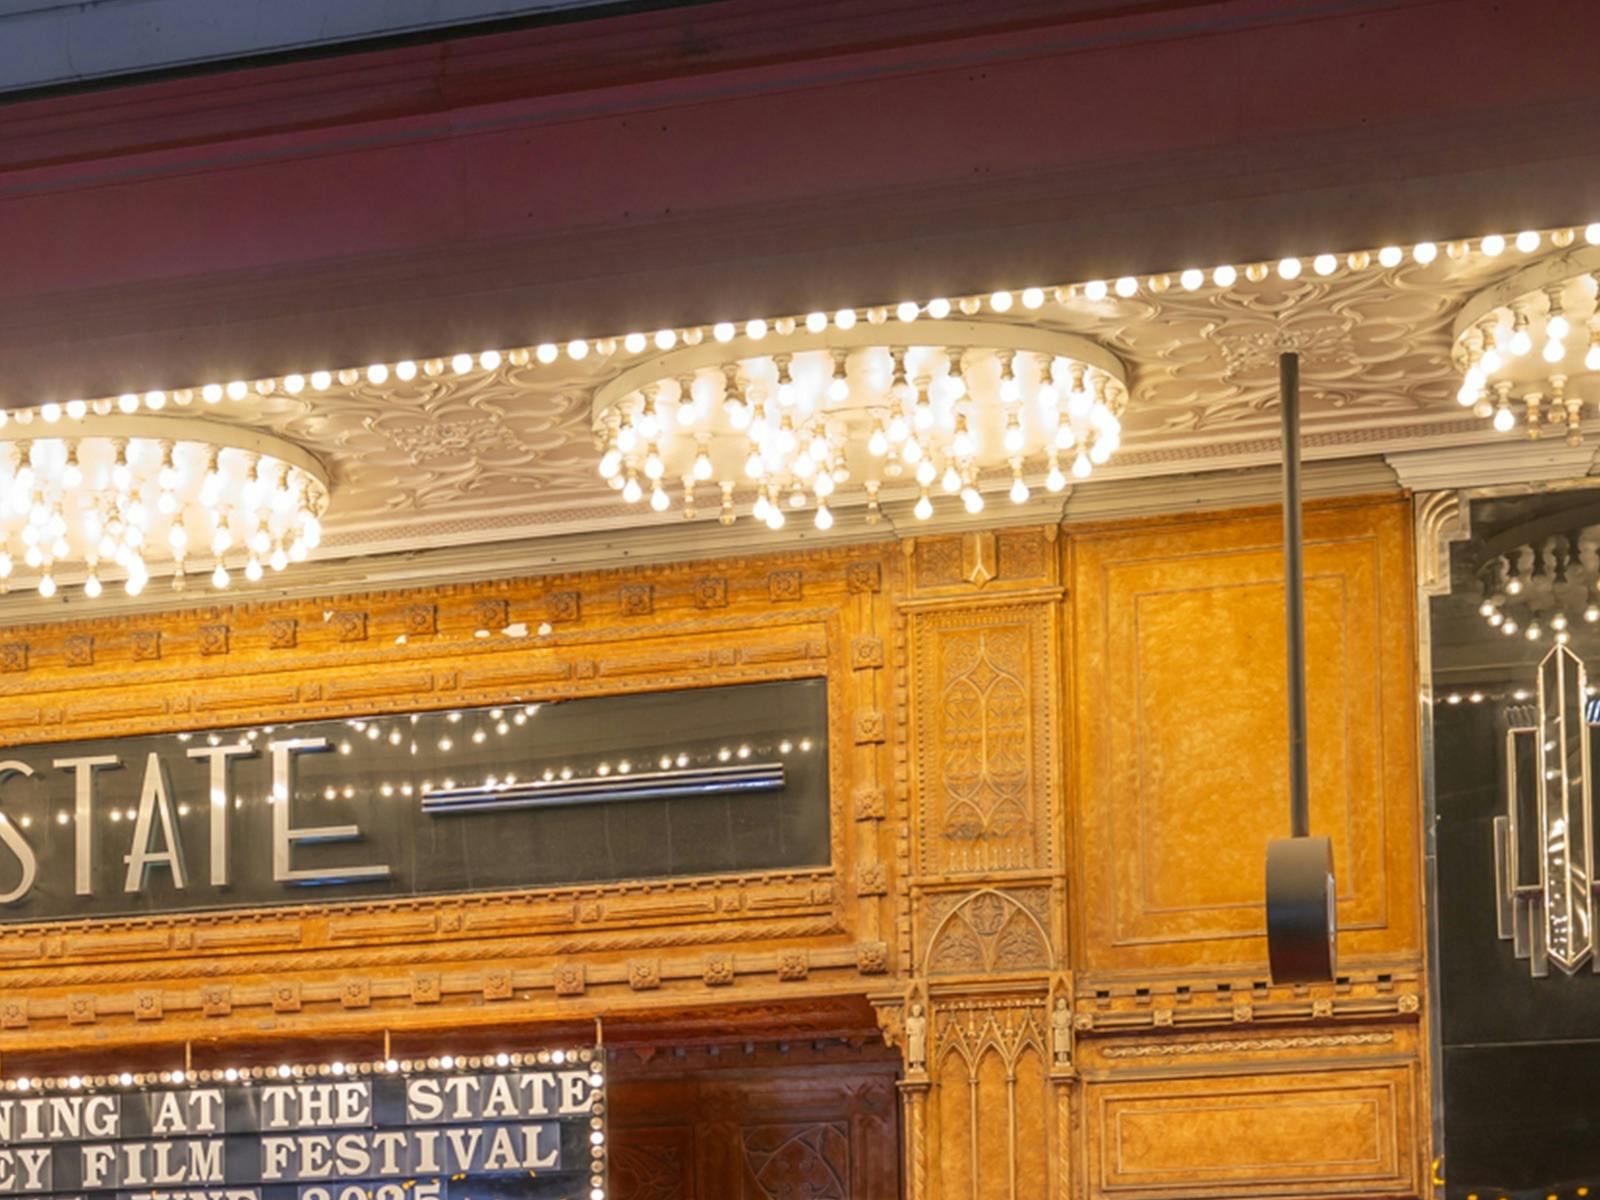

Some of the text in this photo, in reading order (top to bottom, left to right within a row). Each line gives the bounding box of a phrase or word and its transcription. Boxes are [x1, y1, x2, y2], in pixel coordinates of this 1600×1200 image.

[153, 1088, 223, 1133] AT
[263, 1082, 370, 1128] THE
[407, 1072, 596, 1120] STATE
[82, 1140, 226, 1188] FILM
[262, 1126, 558, 1180] FESTIVAL
